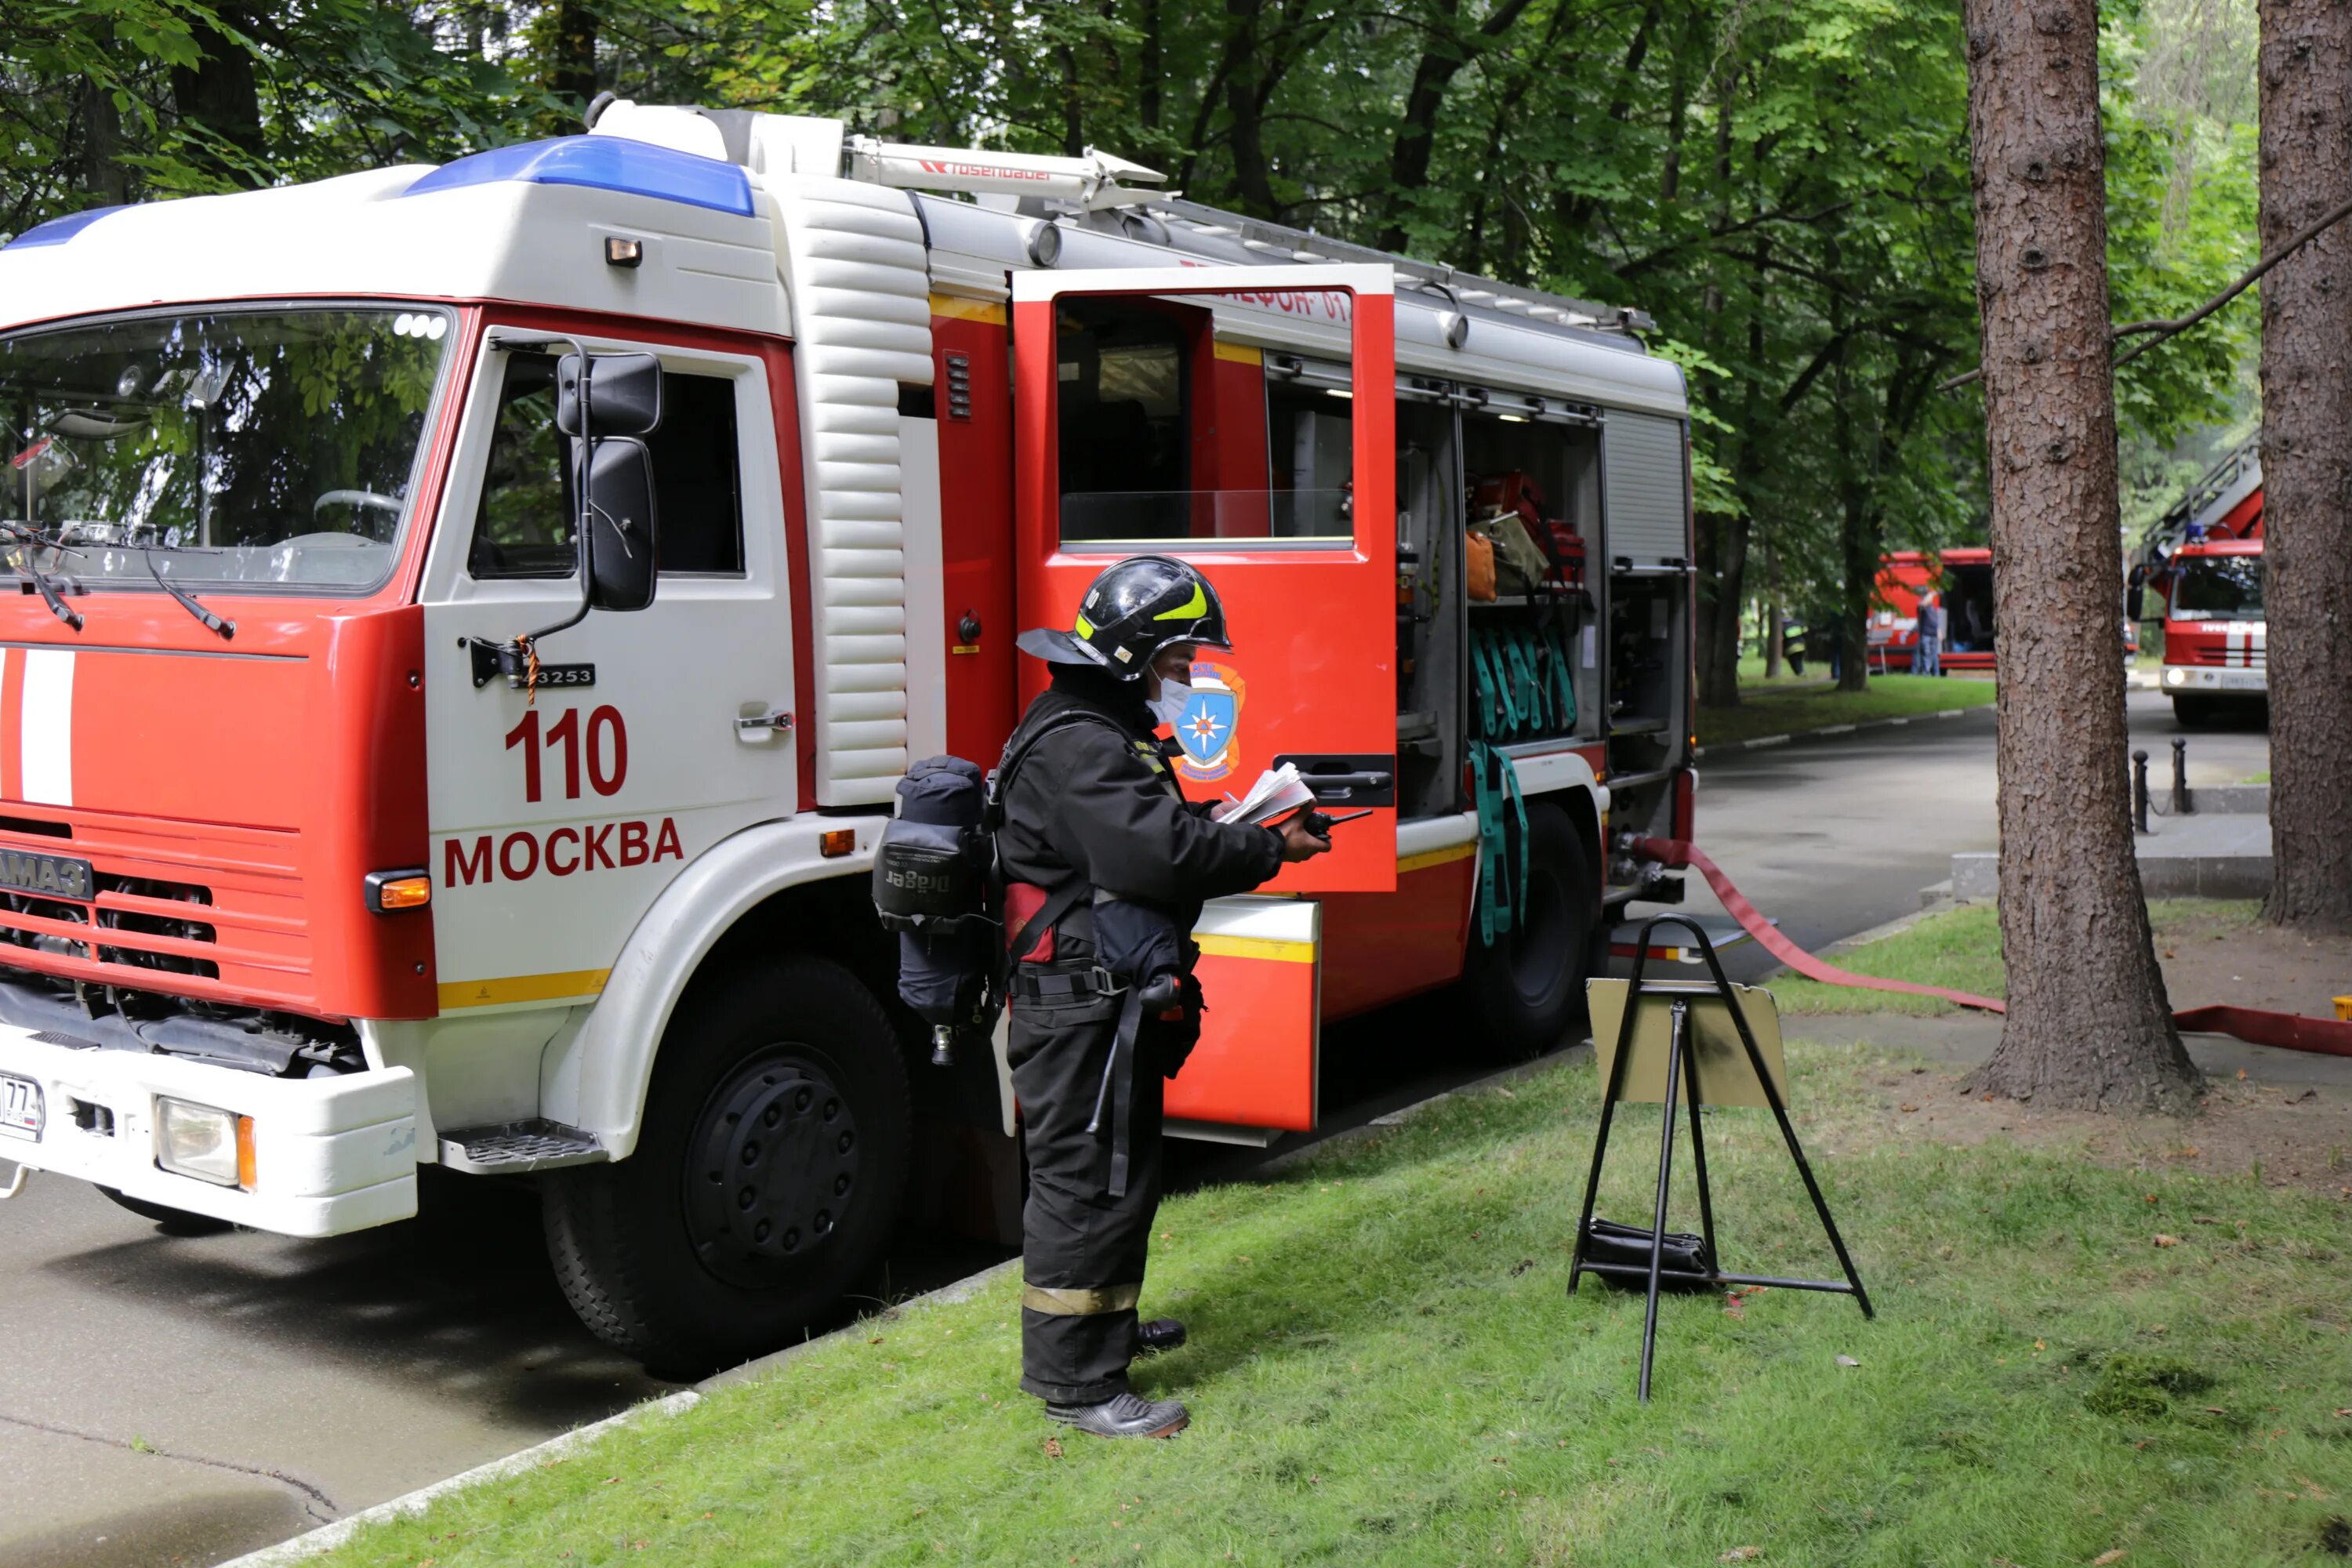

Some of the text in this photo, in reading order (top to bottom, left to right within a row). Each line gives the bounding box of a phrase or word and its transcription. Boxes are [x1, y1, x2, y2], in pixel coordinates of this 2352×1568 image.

[505, 704, 628, 803] 110
[445, 817, 684, 888] МОСКВА
[885, 870, 950, 894] Dräger
[6, 1081, 27, 1111] 77
